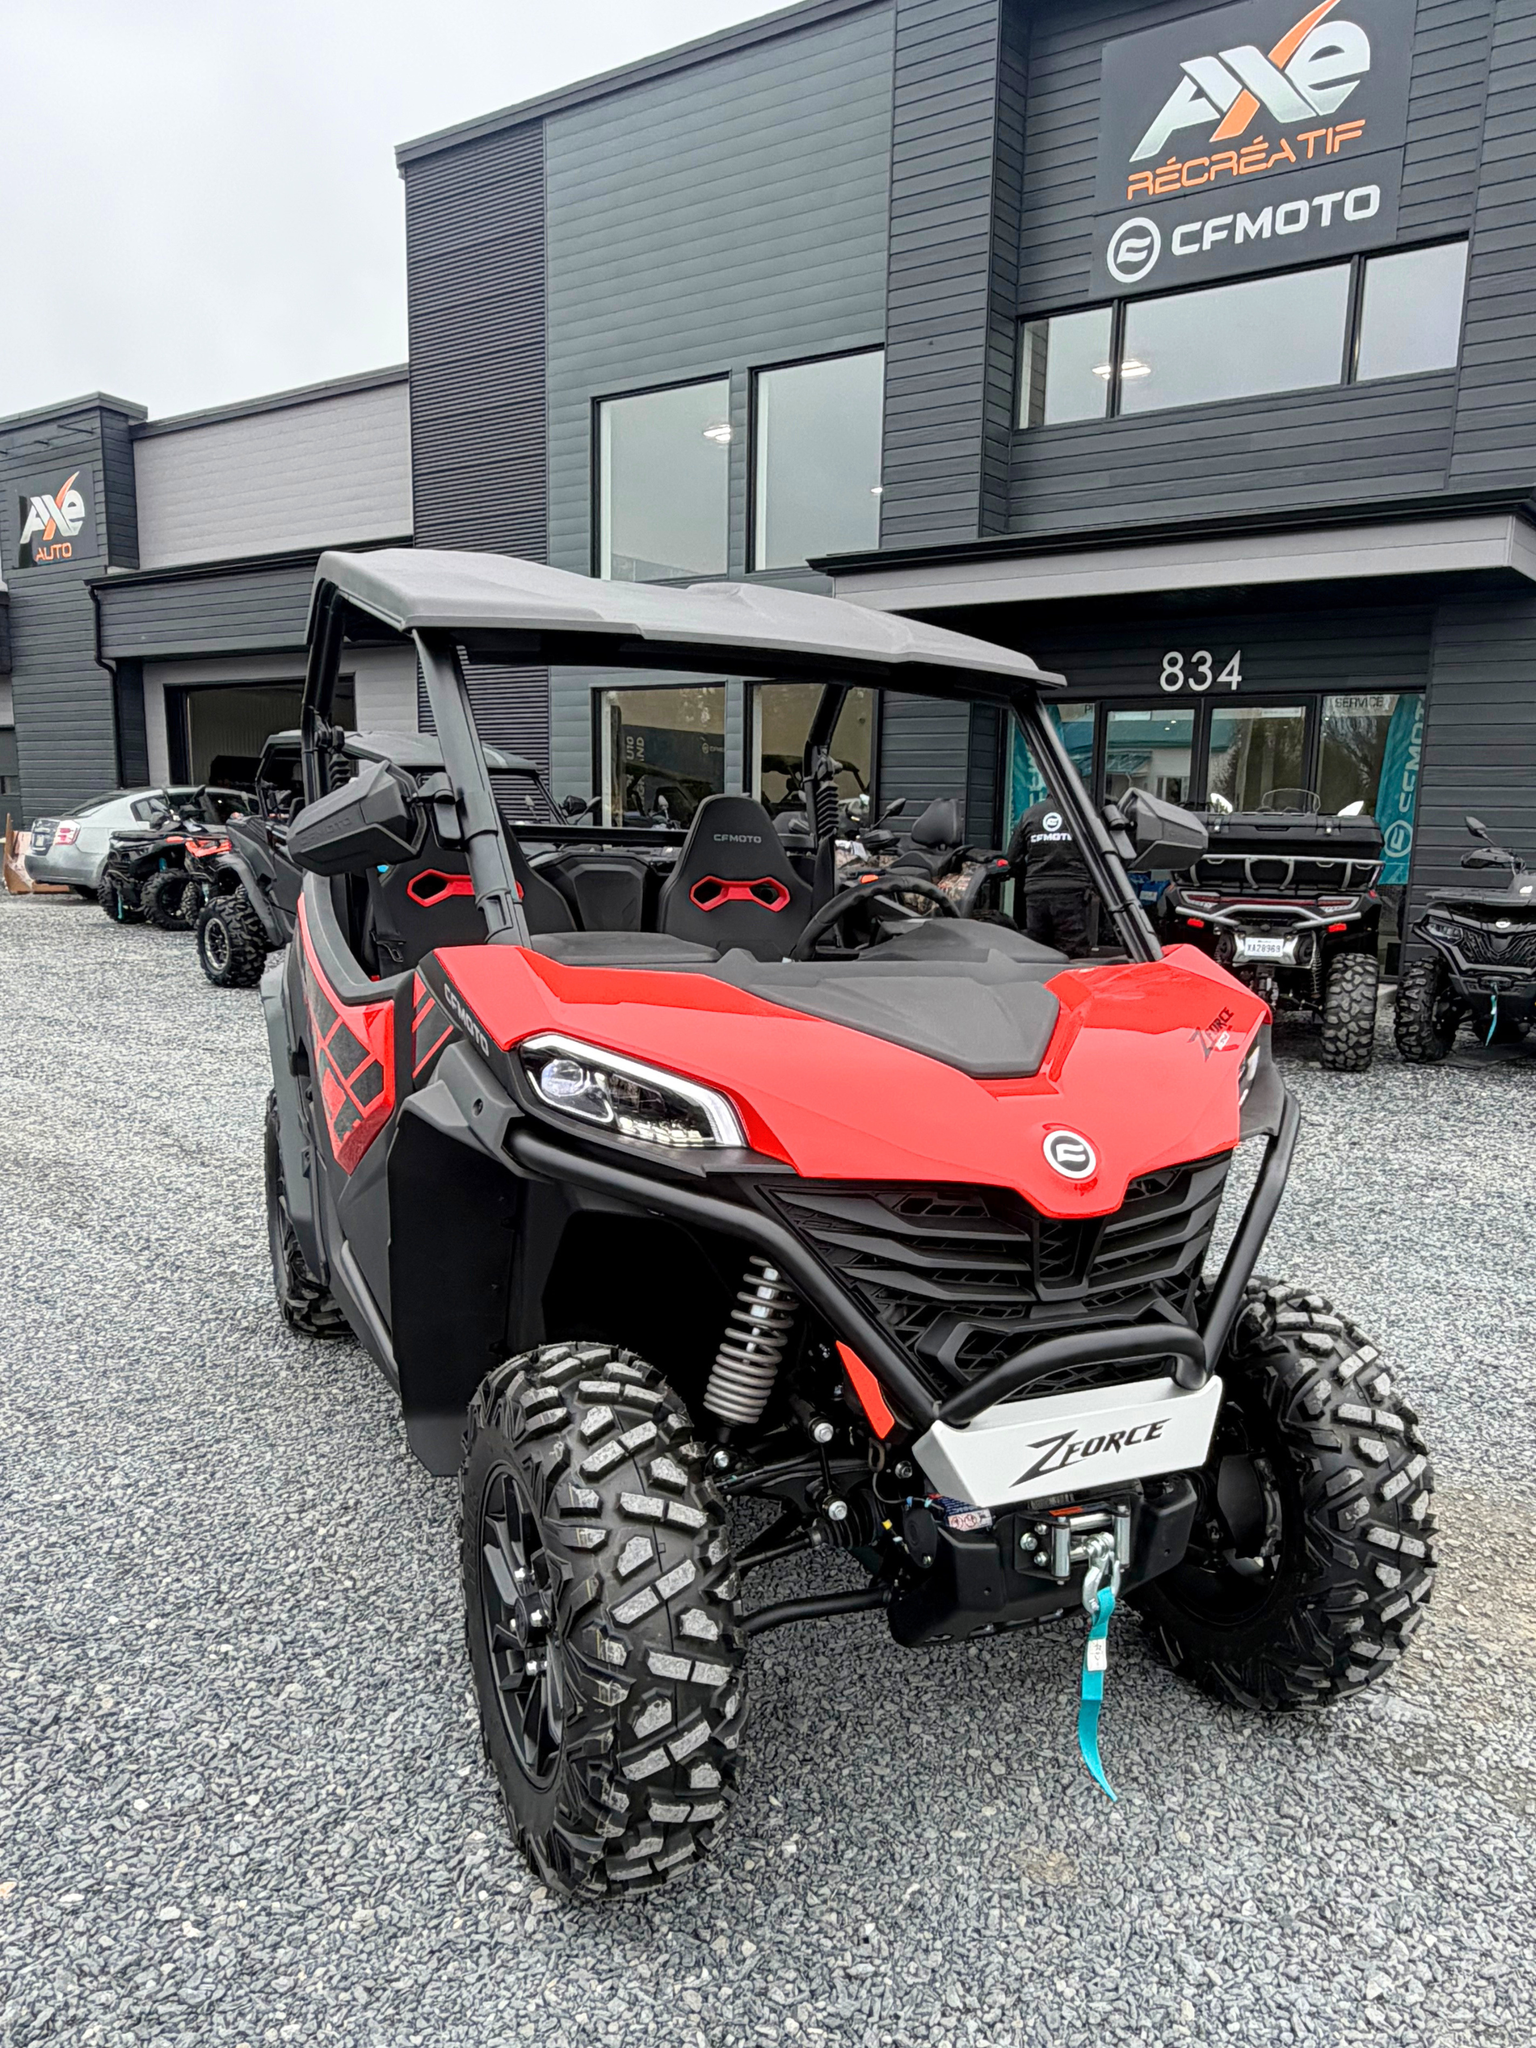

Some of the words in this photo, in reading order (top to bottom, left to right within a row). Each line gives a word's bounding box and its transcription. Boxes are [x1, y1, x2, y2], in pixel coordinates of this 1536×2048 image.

[1126, 118, 1366, 200] RÉCRÉATIF
[1171, 184, 1381, 256] CFMOTO
[35, 542, 73, 562] AUTO
[1160, 650, 1242, 692] 834
[1334, 696, 1384, 708] SERVICE
[713, 833, 762, 844] CFMOTO
[443, 983, 489, 1057] CFMOTO
[1008, 1418, 1172, 1489] ZFORCE
